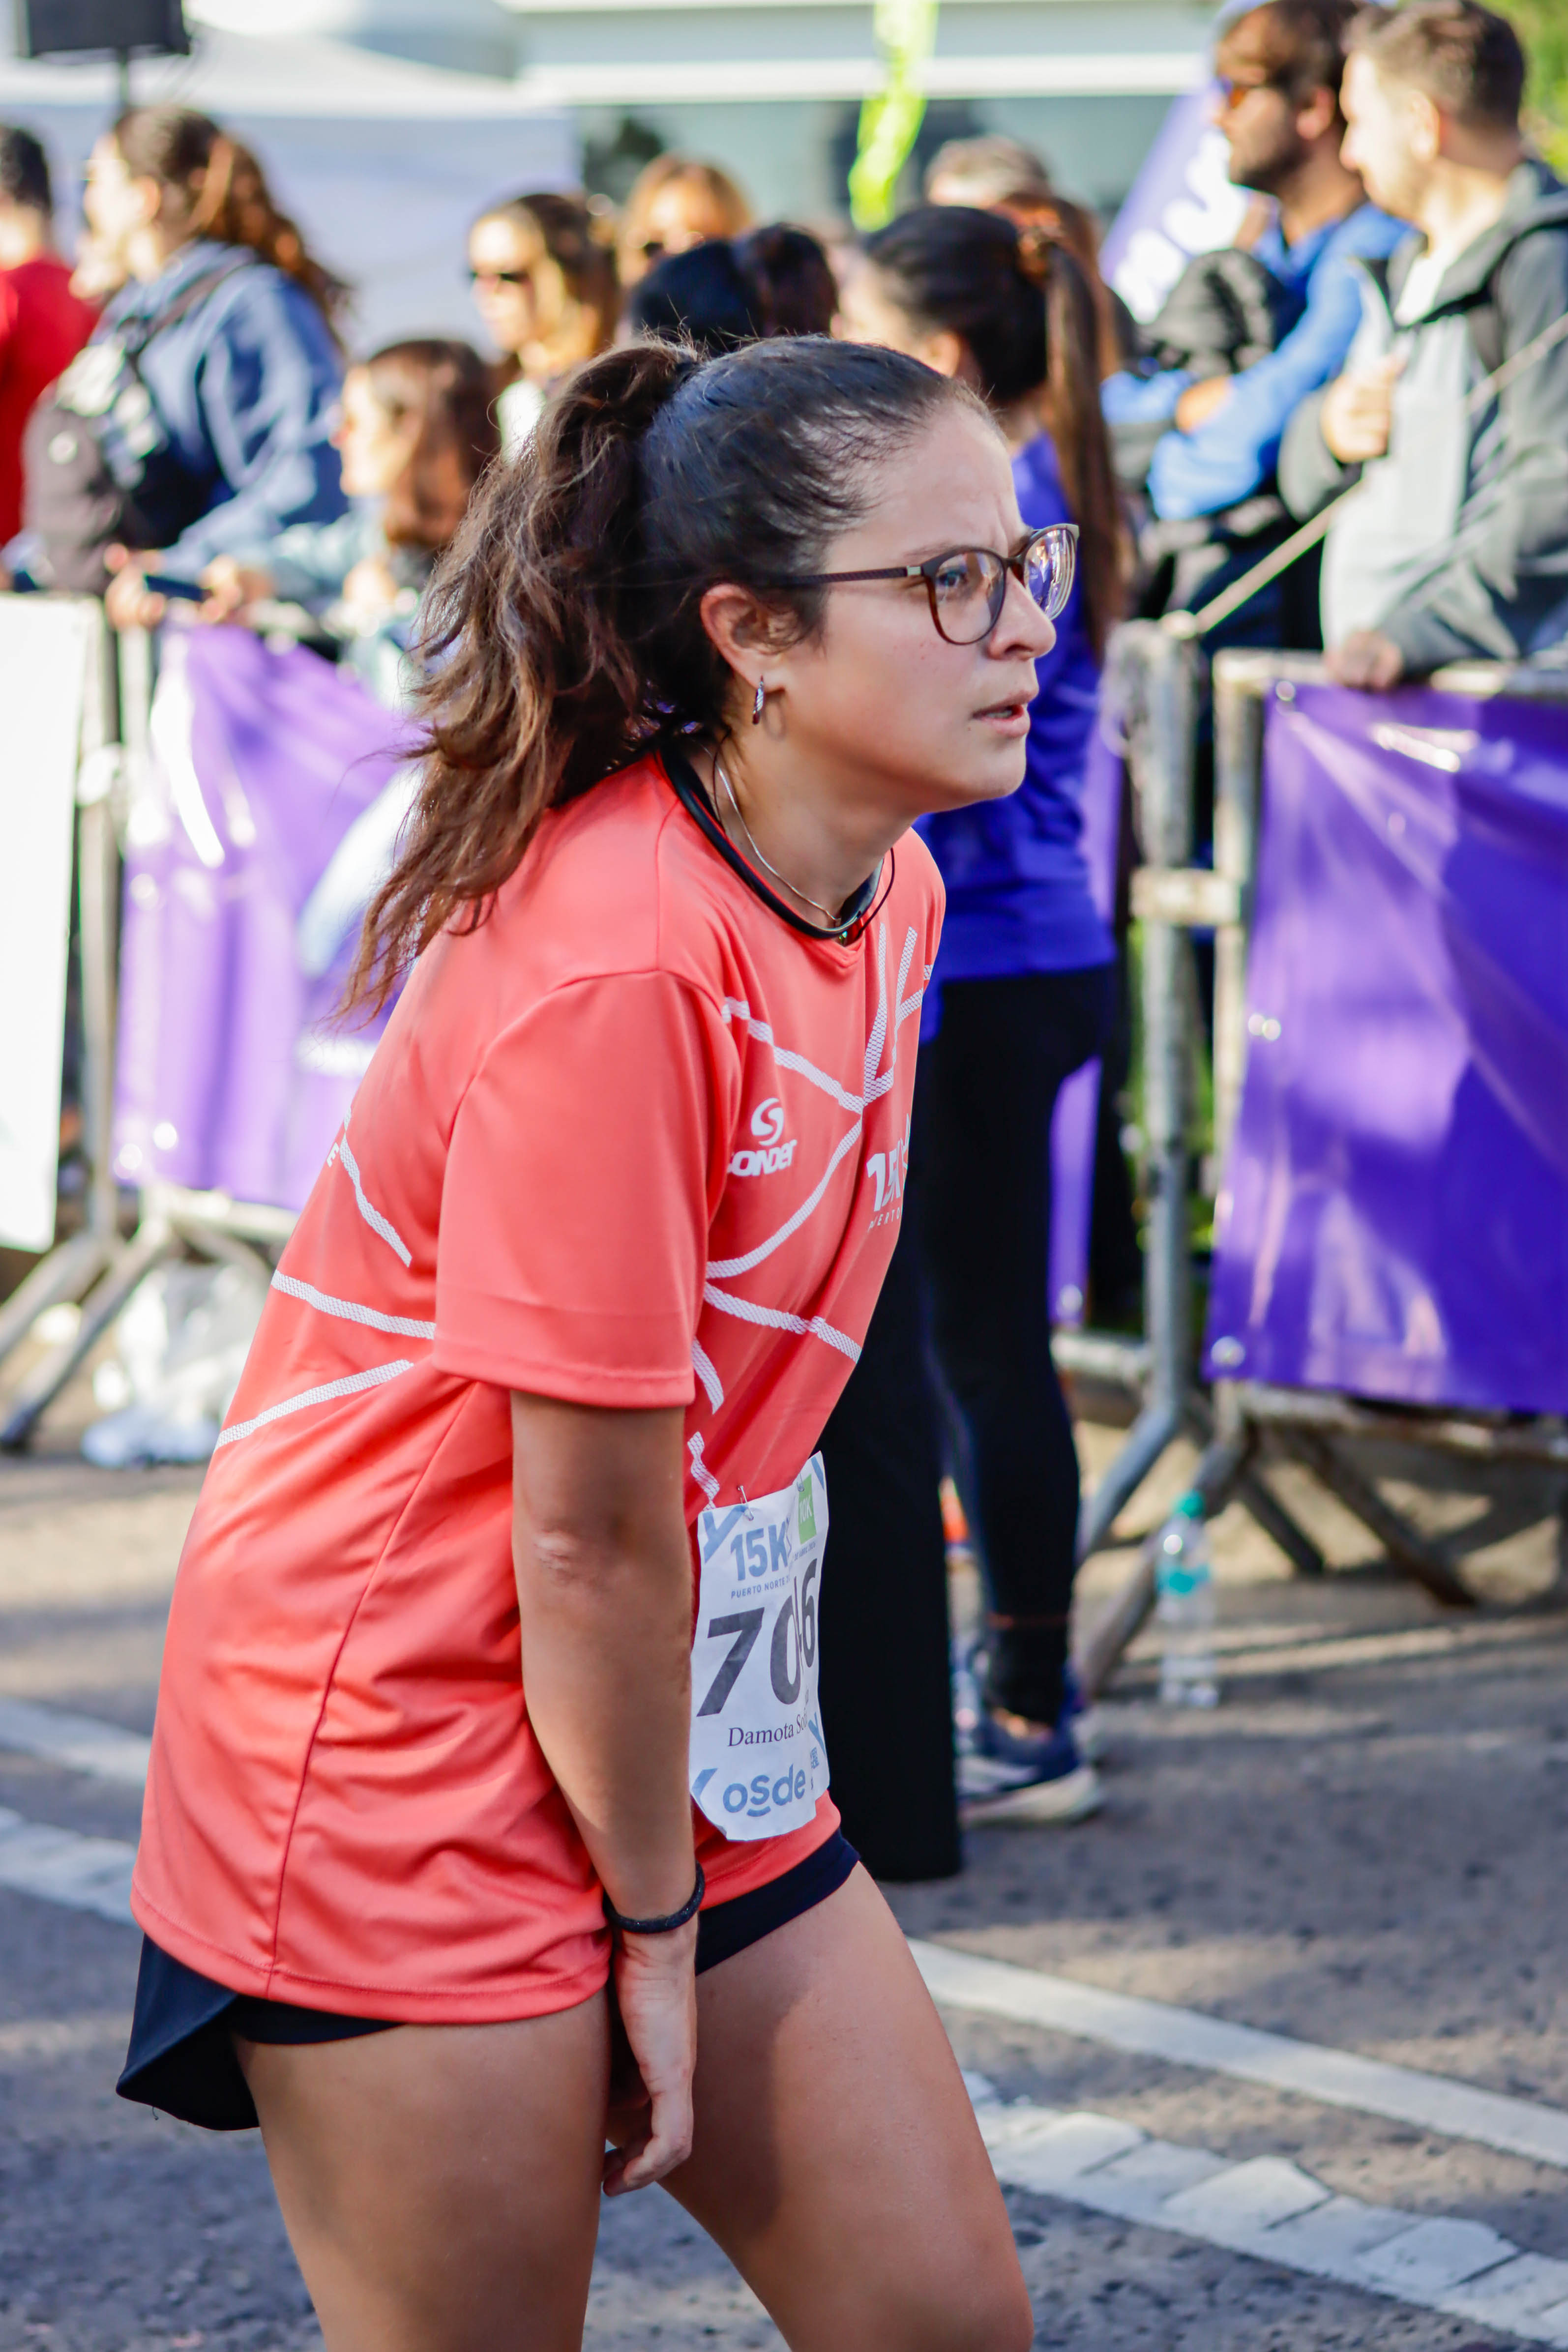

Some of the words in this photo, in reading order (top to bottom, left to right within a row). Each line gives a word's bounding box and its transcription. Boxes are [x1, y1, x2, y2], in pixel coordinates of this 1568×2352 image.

[799, 1495, 812, 1523] 10K
[731, 1520, 788, 1582] 15K
[731, 1584, 762, 1599] PUERTO
[764, 1576, 785, 1591] NORTE
[728, 1723, 794, 1747] Damota
[723, 1763, 806, 1813] osde
